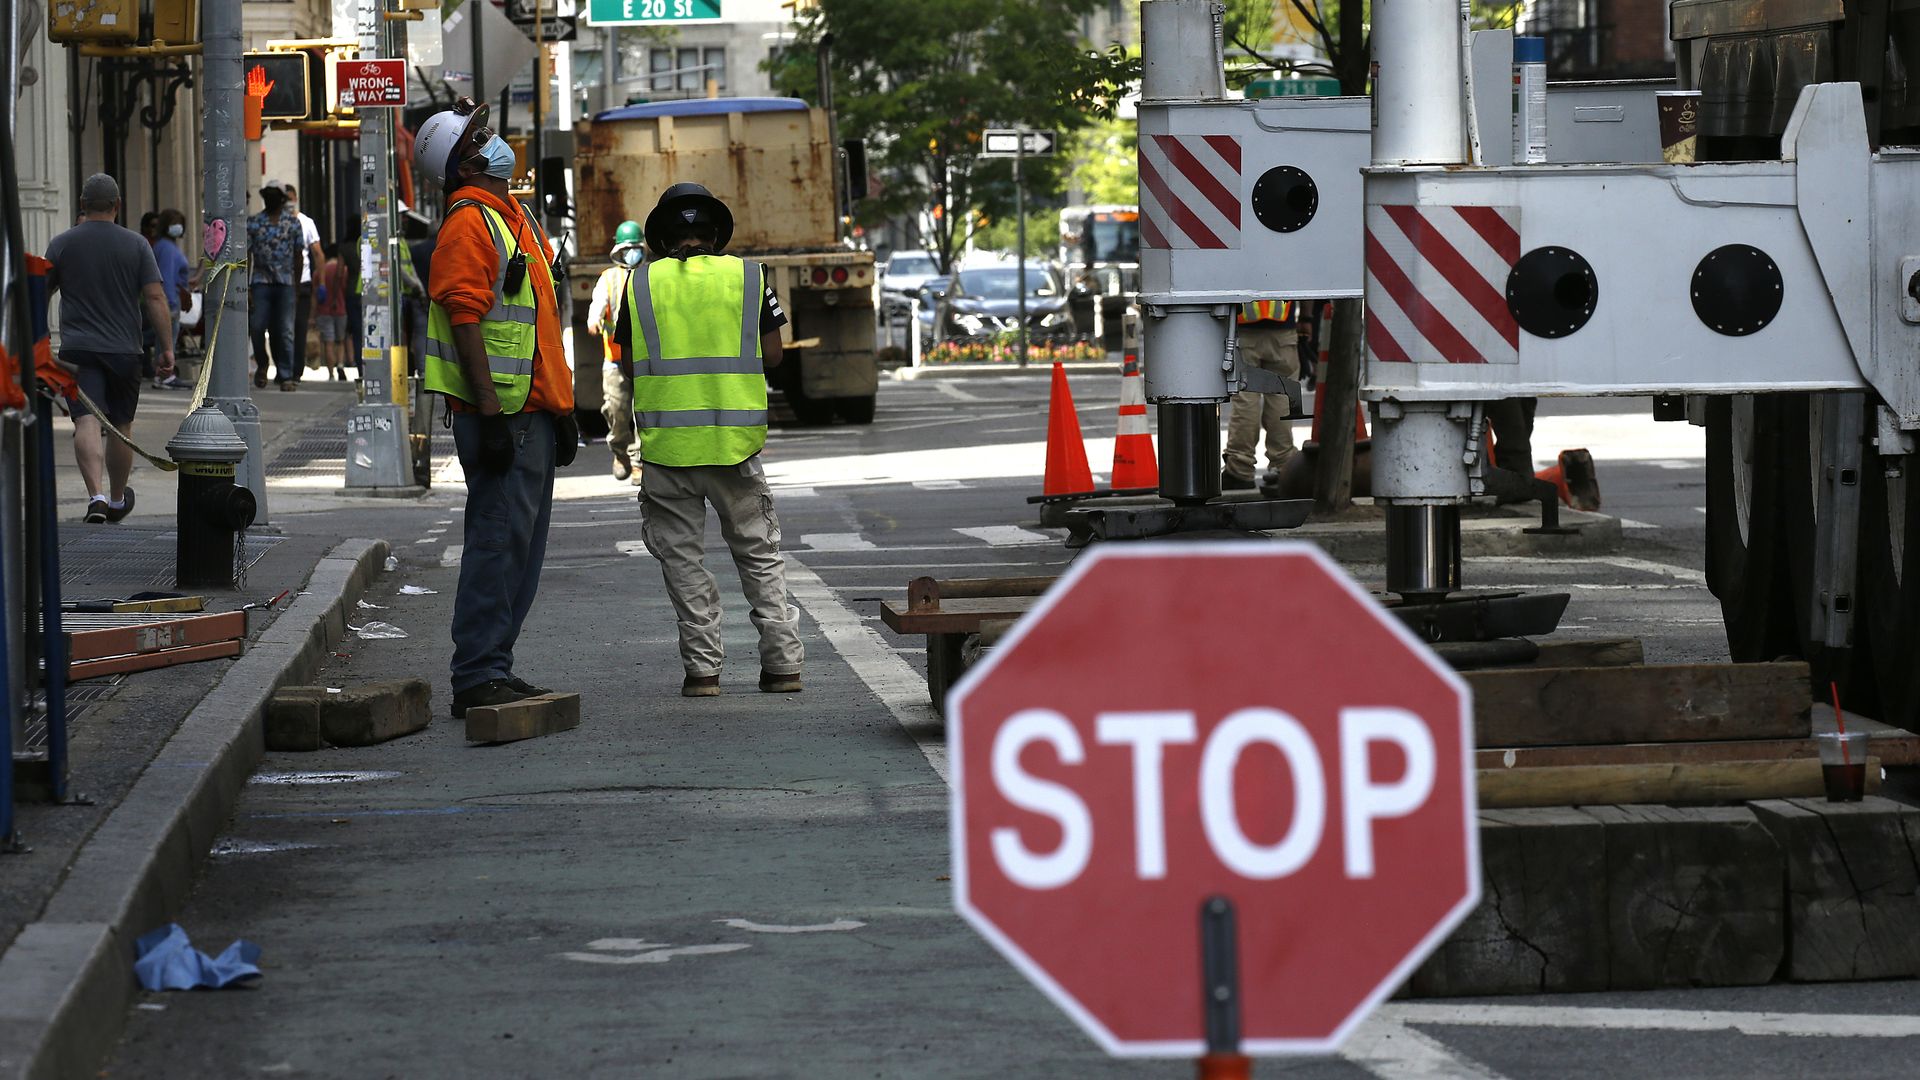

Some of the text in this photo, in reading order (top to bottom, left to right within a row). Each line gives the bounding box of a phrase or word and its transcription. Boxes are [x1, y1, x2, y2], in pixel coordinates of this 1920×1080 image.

[623, 0, 693, 18] E 20 St
[349, 76, 393, 89] WRONG
[357, 90, 385, 102] WAY
[990, 707, 1438, 890] STOP
